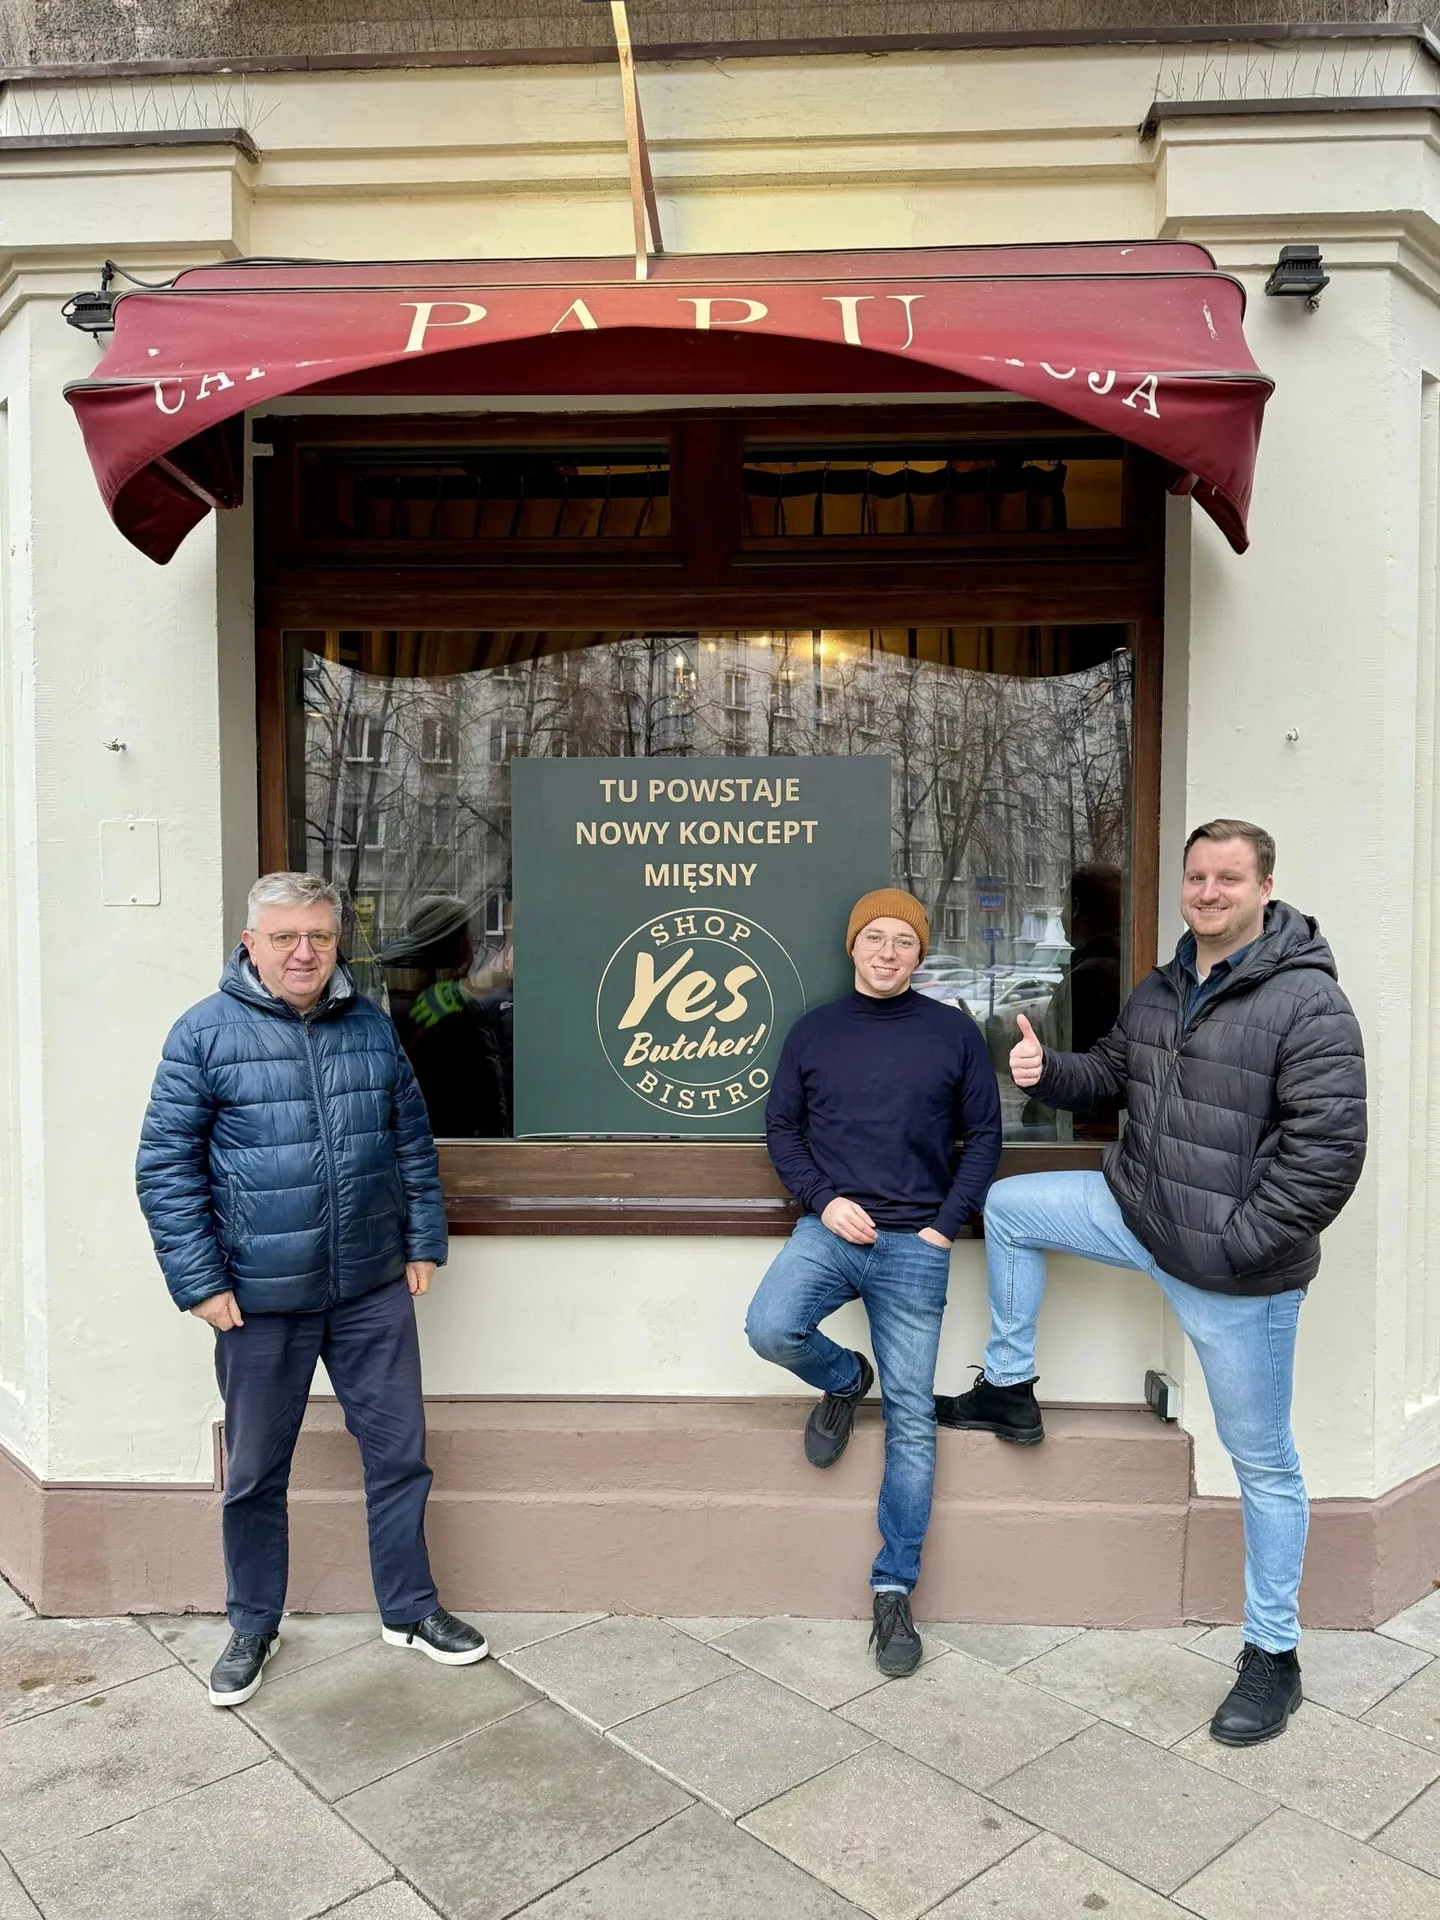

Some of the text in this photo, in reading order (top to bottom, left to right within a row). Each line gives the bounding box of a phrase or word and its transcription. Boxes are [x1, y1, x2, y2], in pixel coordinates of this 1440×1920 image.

[599, 778, 800, 808] TU POWSTAJE
[576, 820, 819, 845] NOWY KONCEPT
[645, 863, 758, 893] MIĘSNY
[650, 914, 751, 946] SHOP
[618, 947, 758, 1030] Yes
[623, 1023, 767, 1067] Butcher!
[636, 1067, 769, 1110] BISTRO
